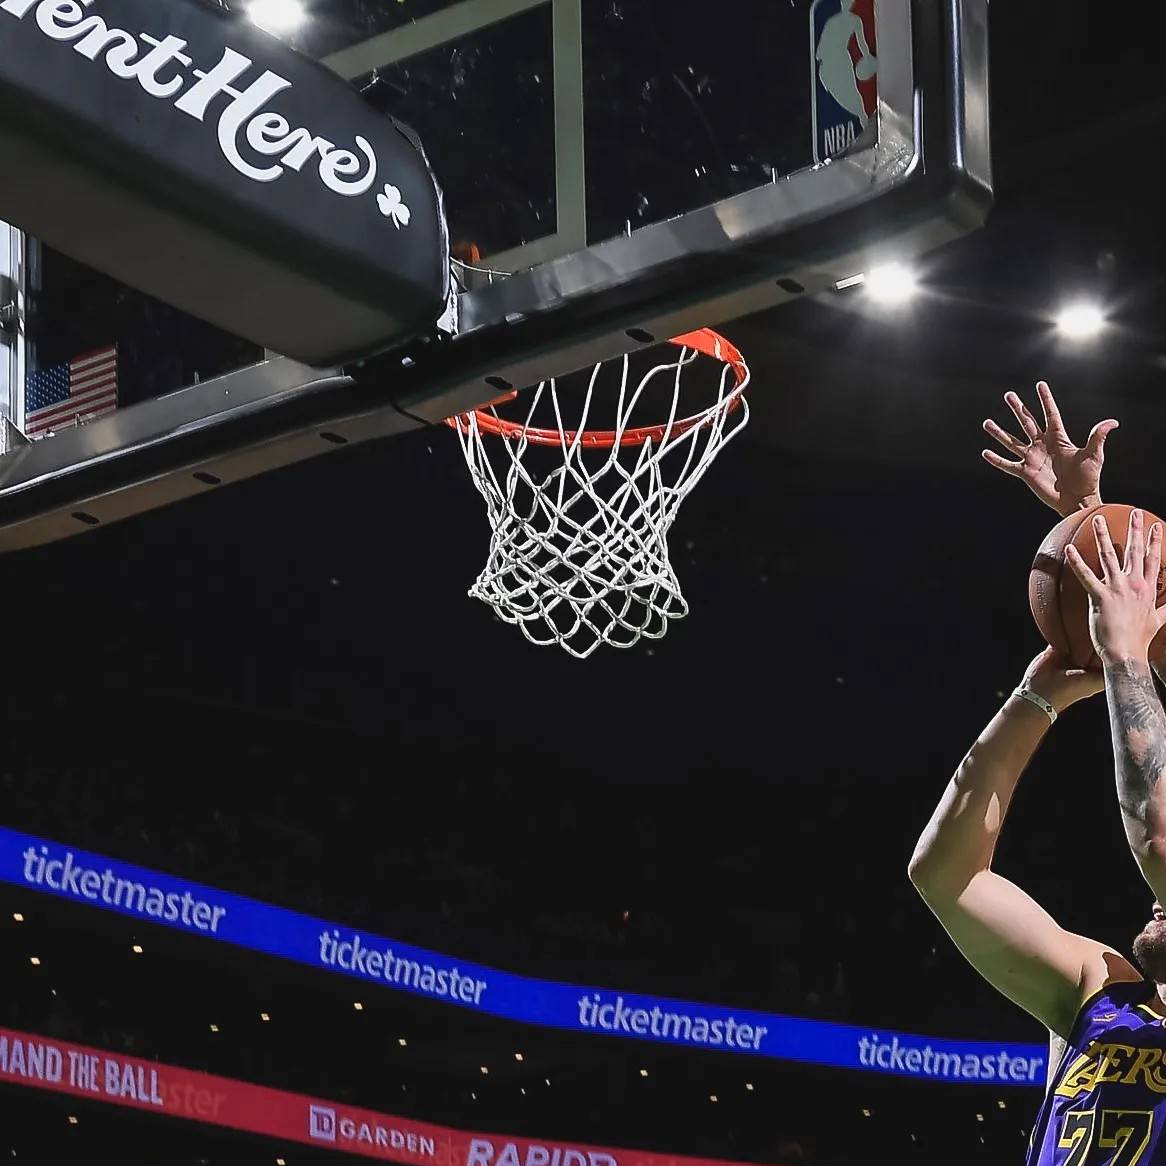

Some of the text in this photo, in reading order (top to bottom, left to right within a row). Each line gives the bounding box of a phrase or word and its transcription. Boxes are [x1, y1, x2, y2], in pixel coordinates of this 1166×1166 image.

[824, 120, 858, 157] NBA
[22, 845, 227, 933] ticketmaster
[317, 929, 488, 1006] ticketmaster
[577, 992, 769, 1051] ticketmaster
[67, 1049, 100, 1093] THE
[104, 1057, 164, 1106] BALL
[857, 1033, 1044, 1081] ticketmaster
[339, 1116, 435, 1157] GARDEN
